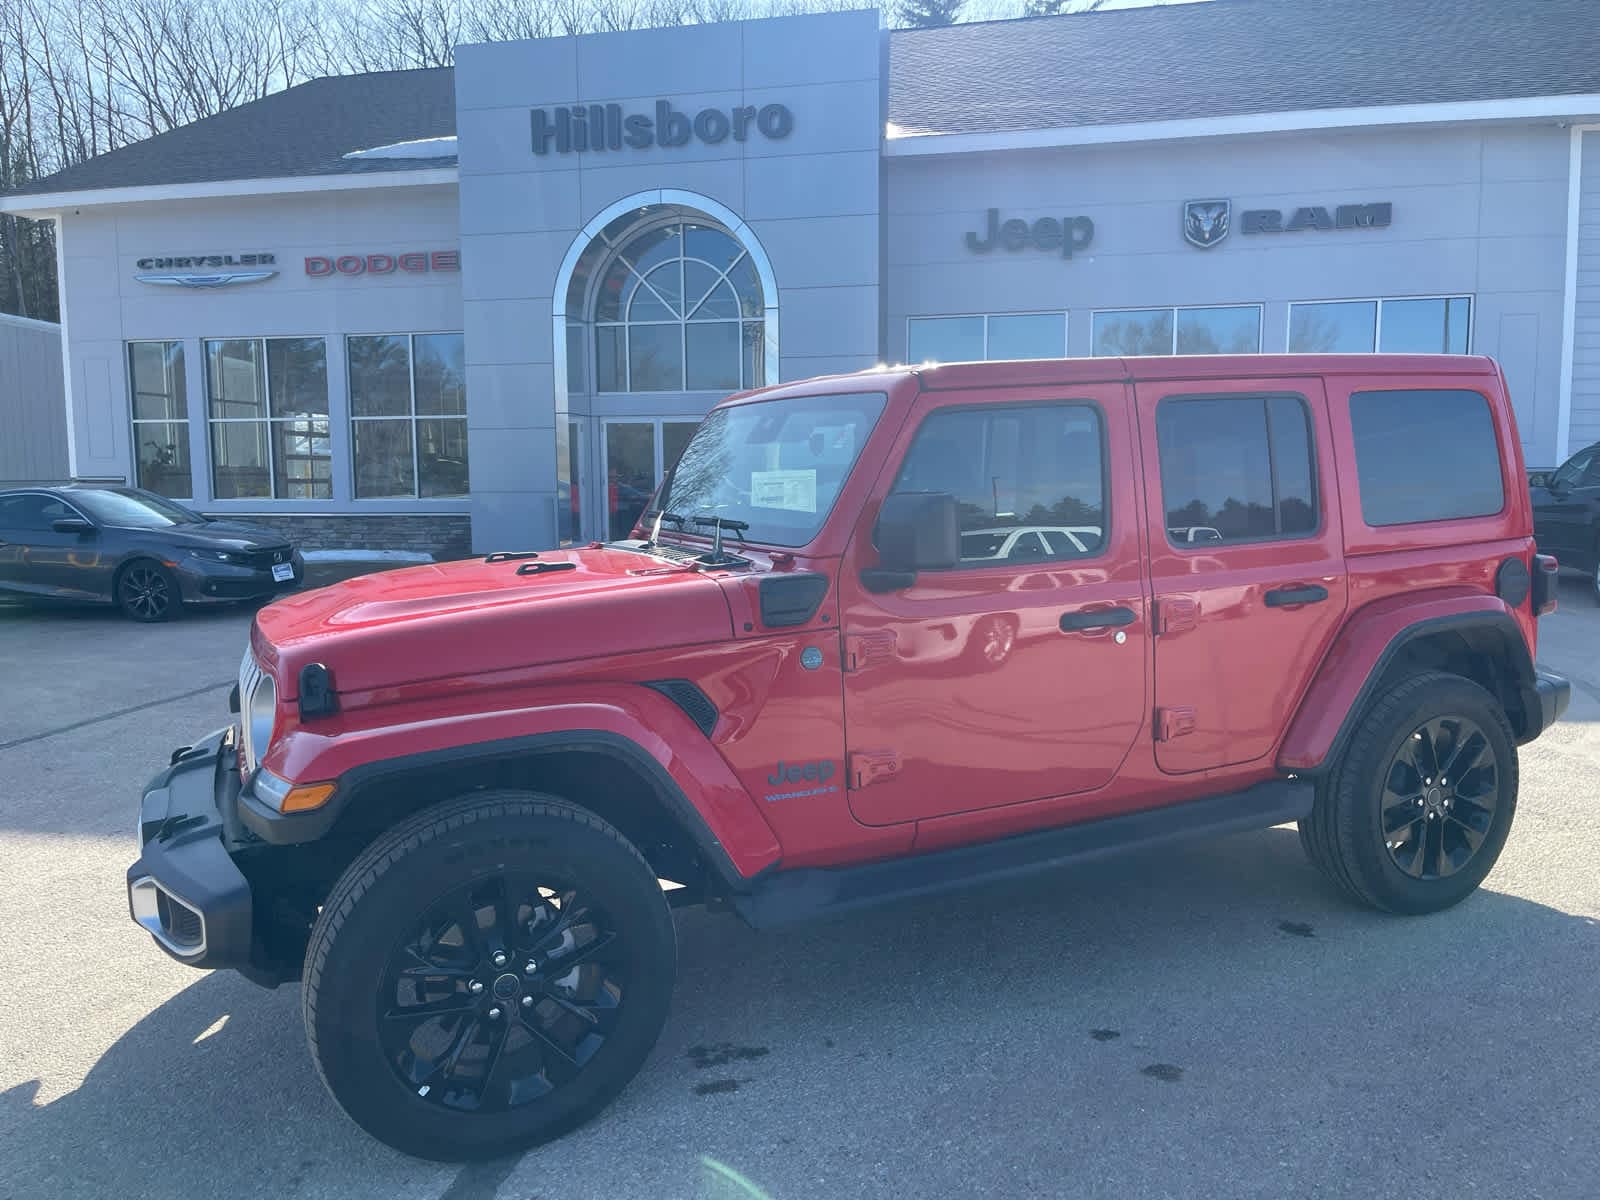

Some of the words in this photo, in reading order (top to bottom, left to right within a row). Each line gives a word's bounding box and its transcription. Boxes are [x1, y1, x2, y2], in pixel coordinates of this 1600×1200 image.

[531, 100, 793, 154] Hillsboro
[966, 207, 1095, 257] Jeep
[1241, 203, 1392, 234] RAM
[137, 253, 276, 269] CHRYSLER
[304, 251, 460, 276] DODGE
[767, 759, 836, 786] Jeep
